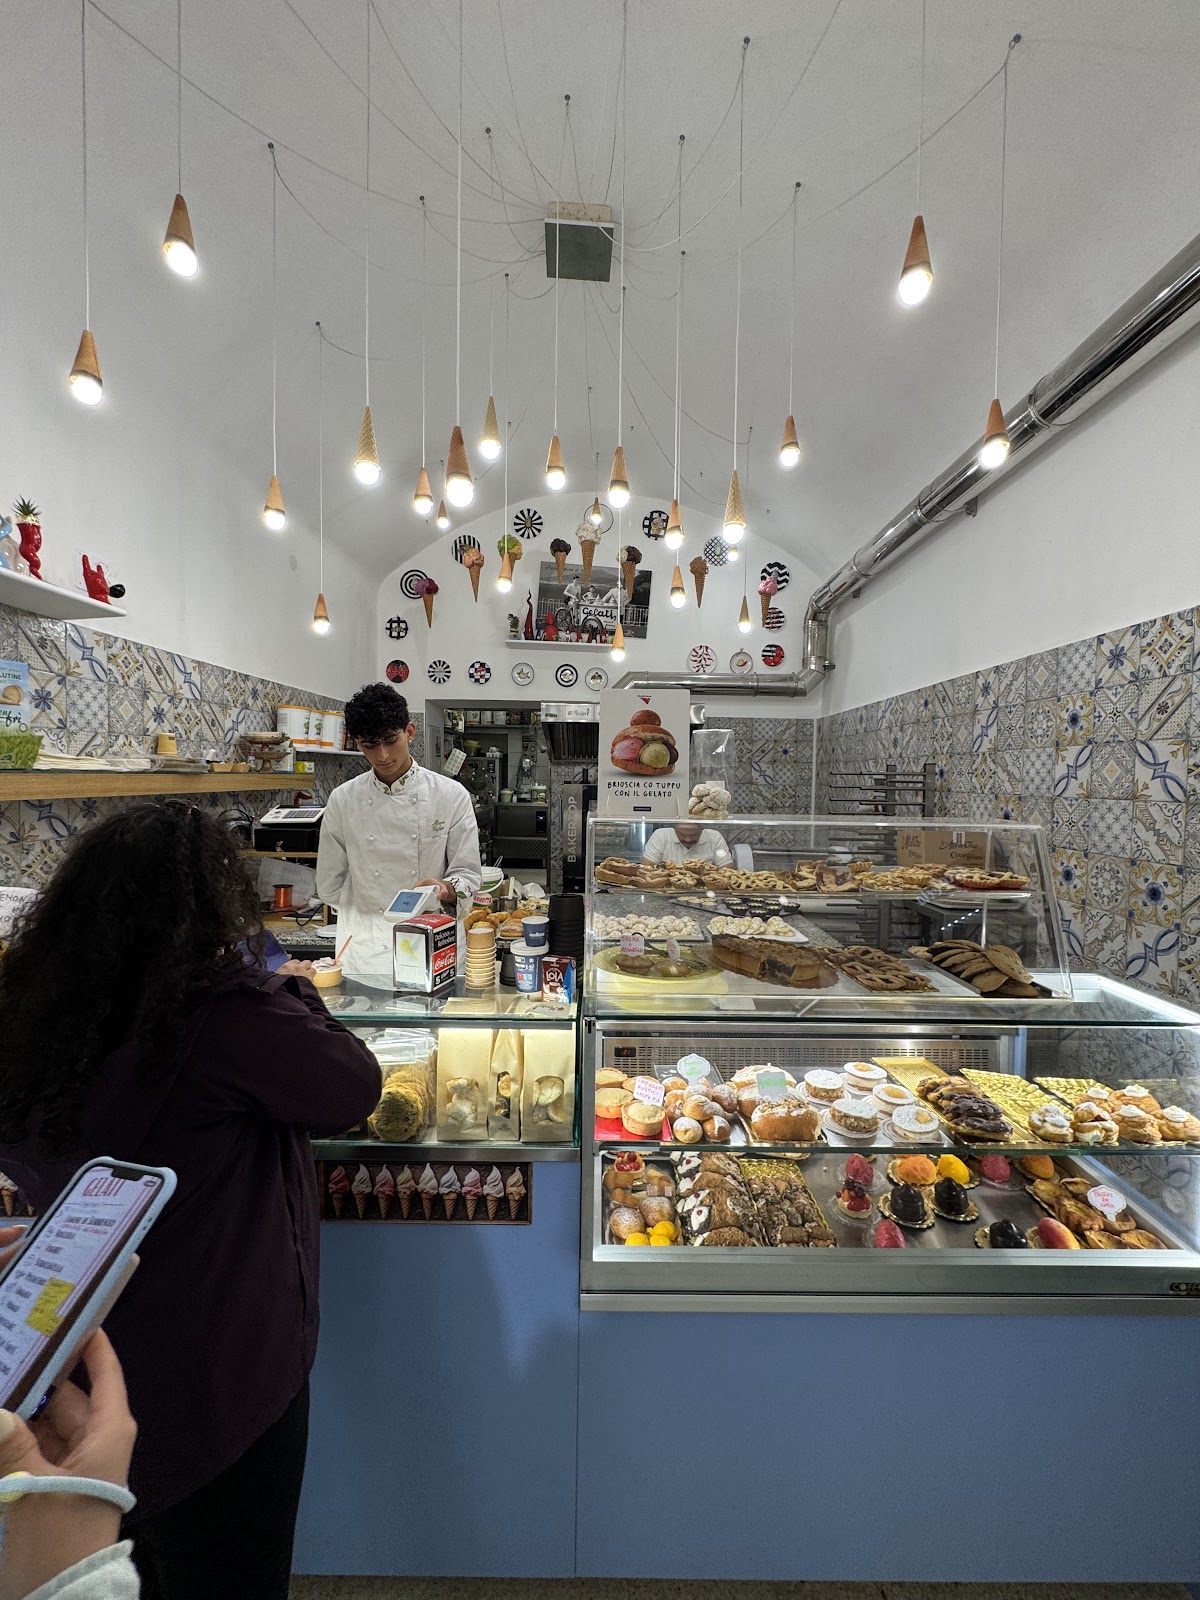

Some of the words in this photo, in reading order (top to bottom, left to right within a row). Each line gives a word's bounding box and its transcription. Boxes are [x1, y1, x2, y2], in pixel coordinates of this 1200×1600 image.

[607, 781, 640, 789] BRIOSCIA
[656, 782, 681, 790] TUPPU
[643, 790, 672, 798] GELATO
[567, 796, 577, 863] BAKERTOP
[435, 976, 441, 985] 5
[449, 968, 455, 977] 5
